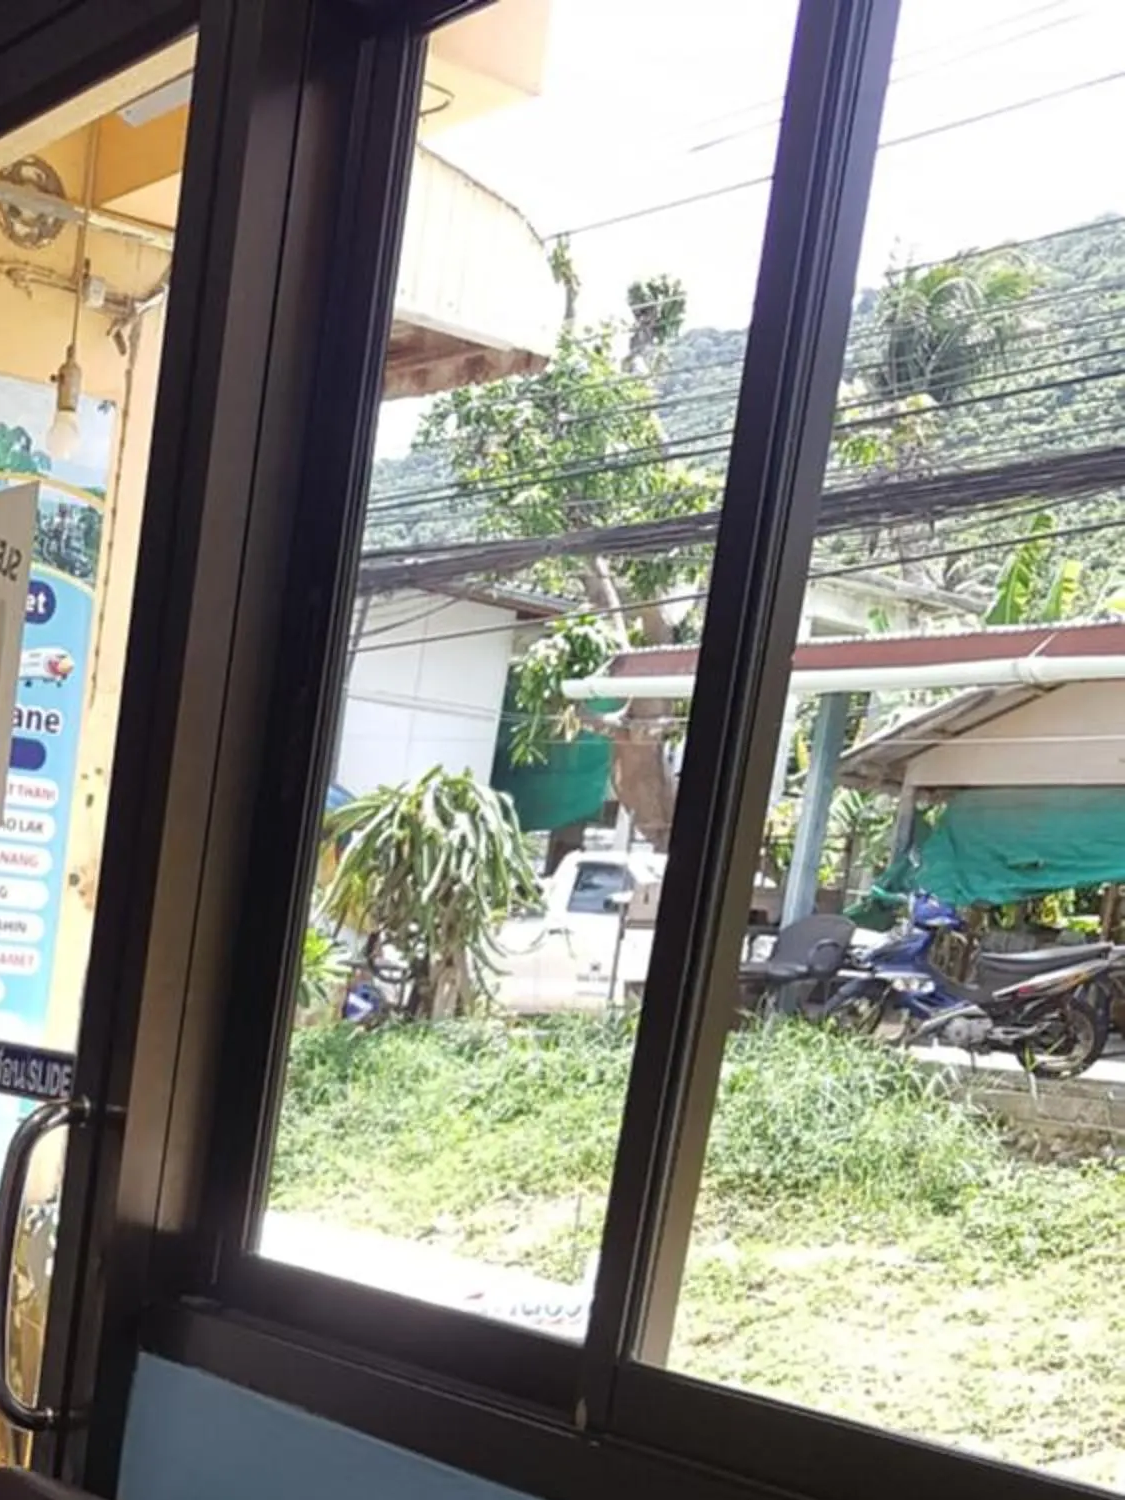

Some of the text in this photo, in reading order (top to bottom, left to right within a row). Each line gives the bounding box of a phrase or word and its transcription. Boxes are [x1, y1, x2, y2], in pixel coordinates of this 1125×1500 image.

[19, 821, 45, 833] LAK
[0, 851, 41, 868] NANG
[27, 1058, 72, 1097] SLIDE
